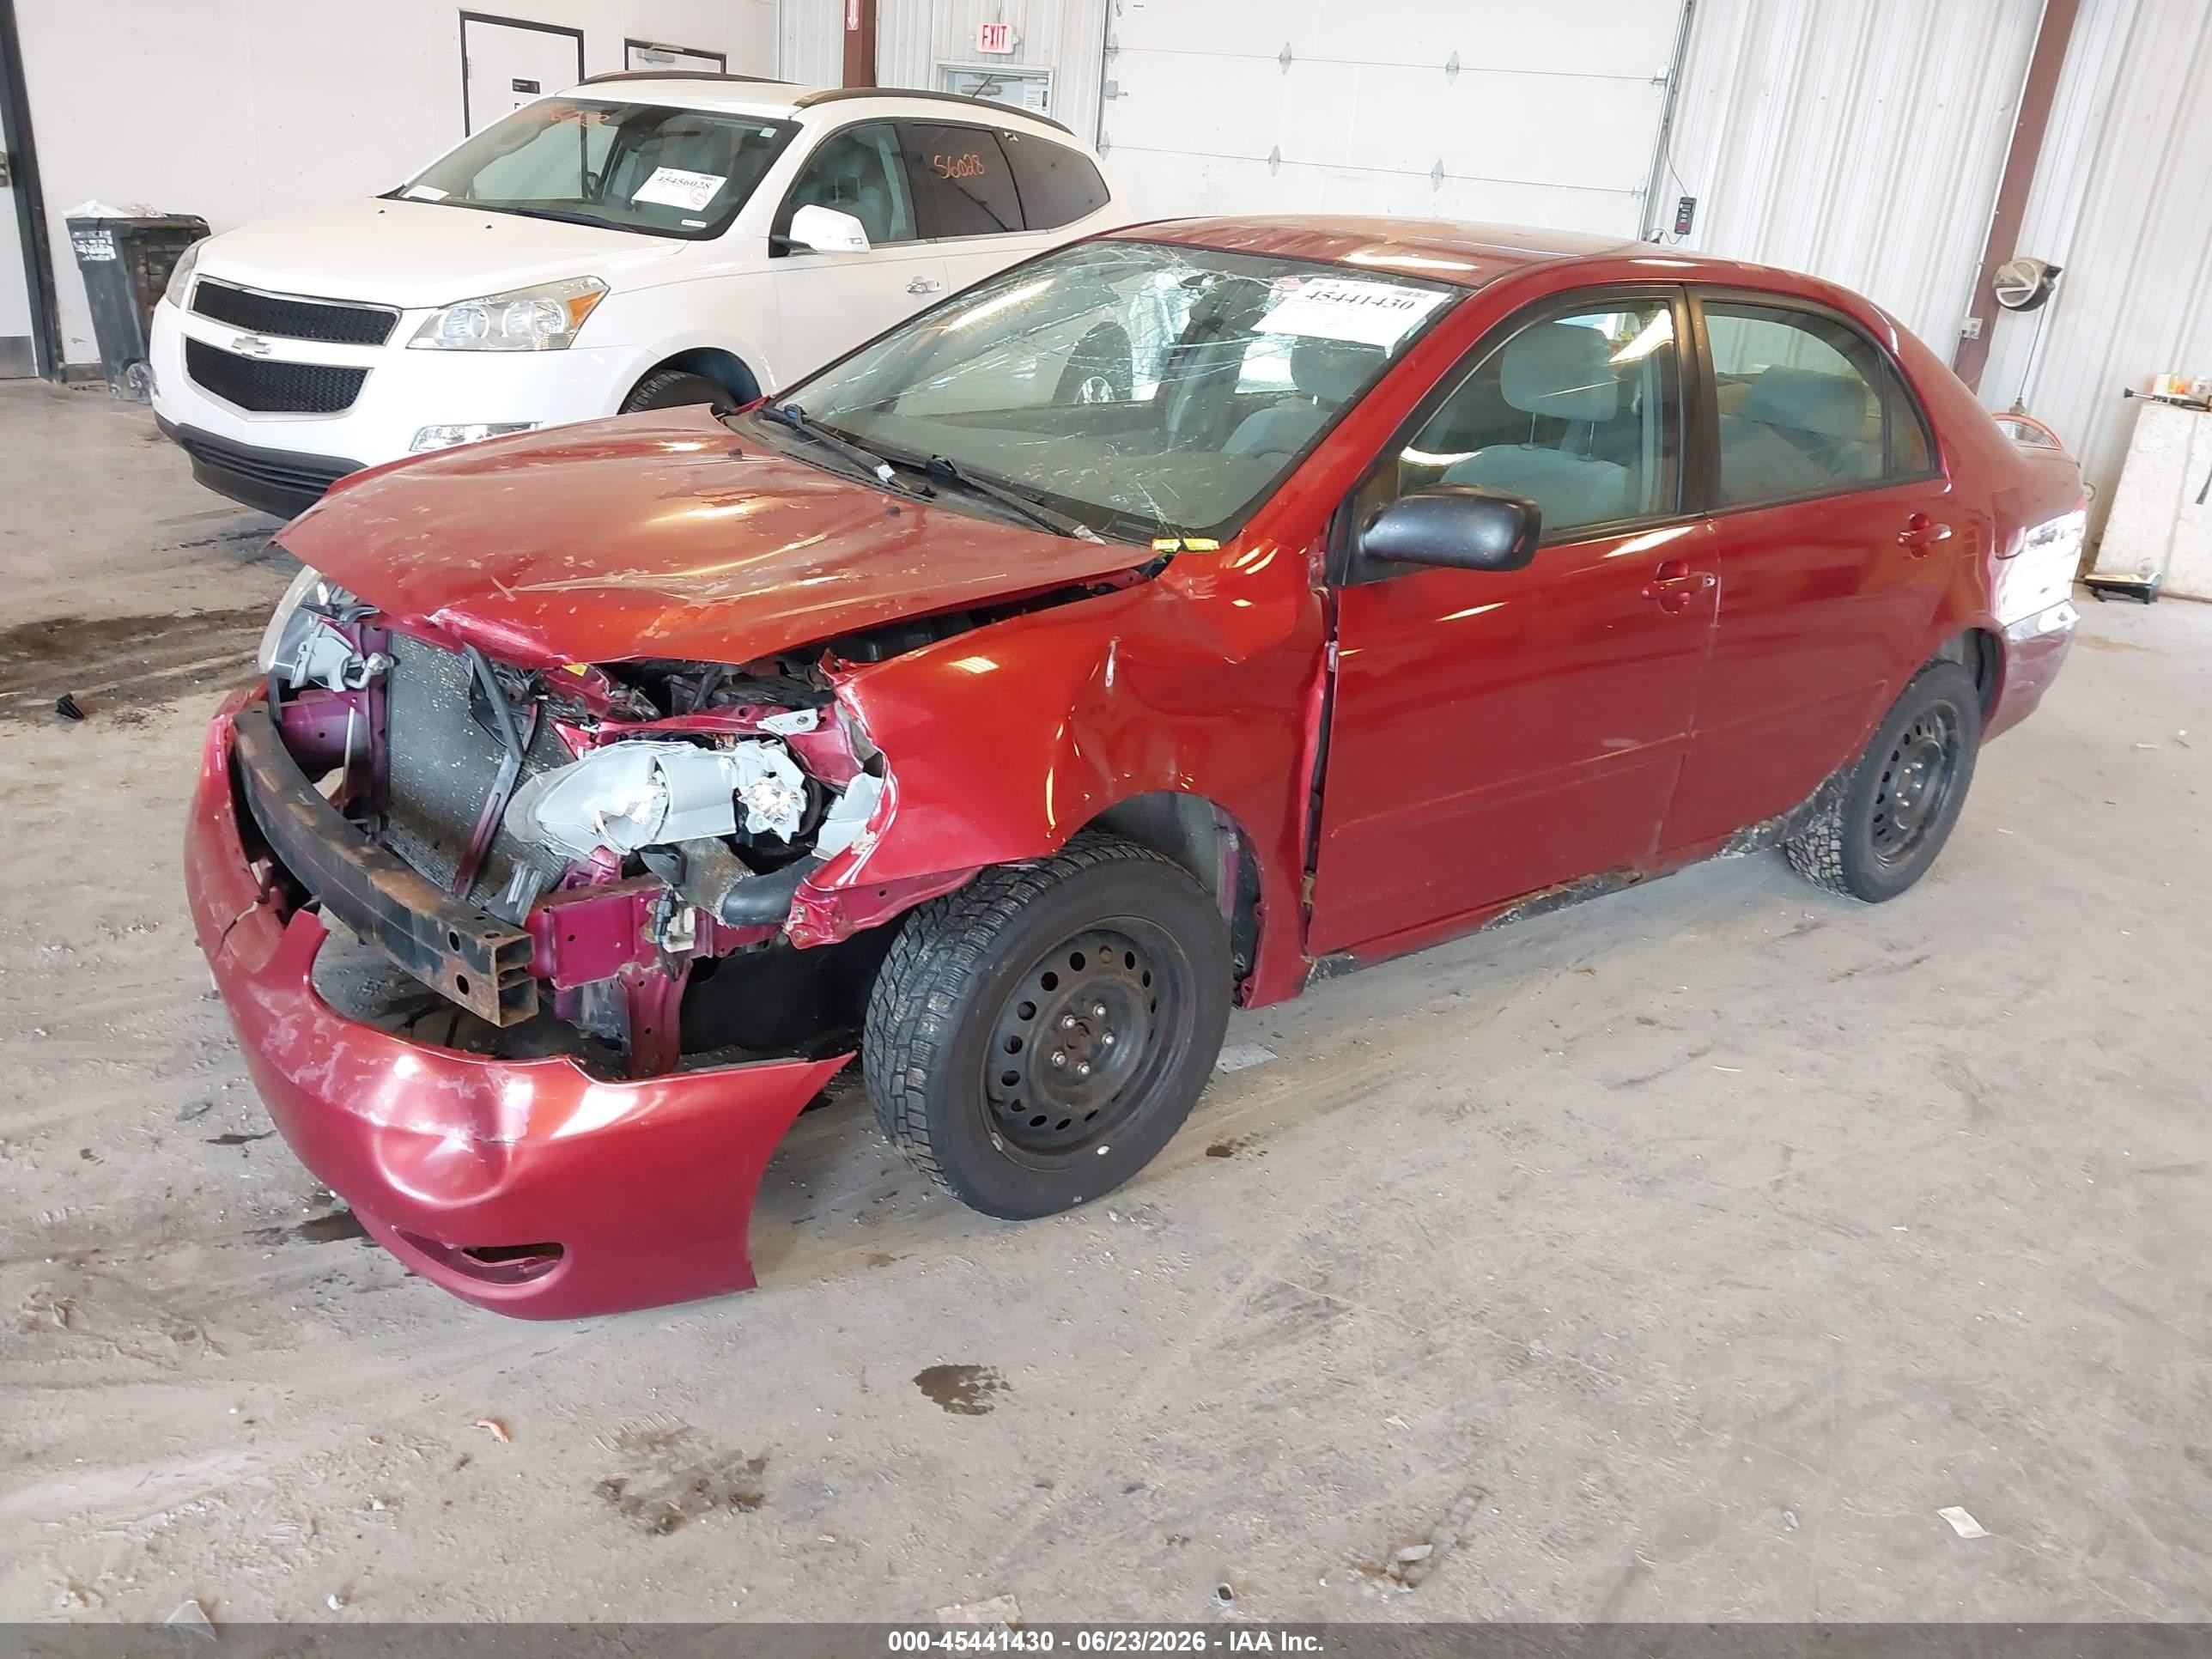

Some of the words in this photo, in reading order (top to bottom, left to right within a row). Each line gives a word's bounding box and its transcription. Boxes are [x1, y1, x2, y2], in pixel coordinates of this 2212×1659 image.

[981, 25, 1007, 49] EXIT
[933, 155, 984, 179] 56028
[1305, 290, 1415, 310] 45441430
